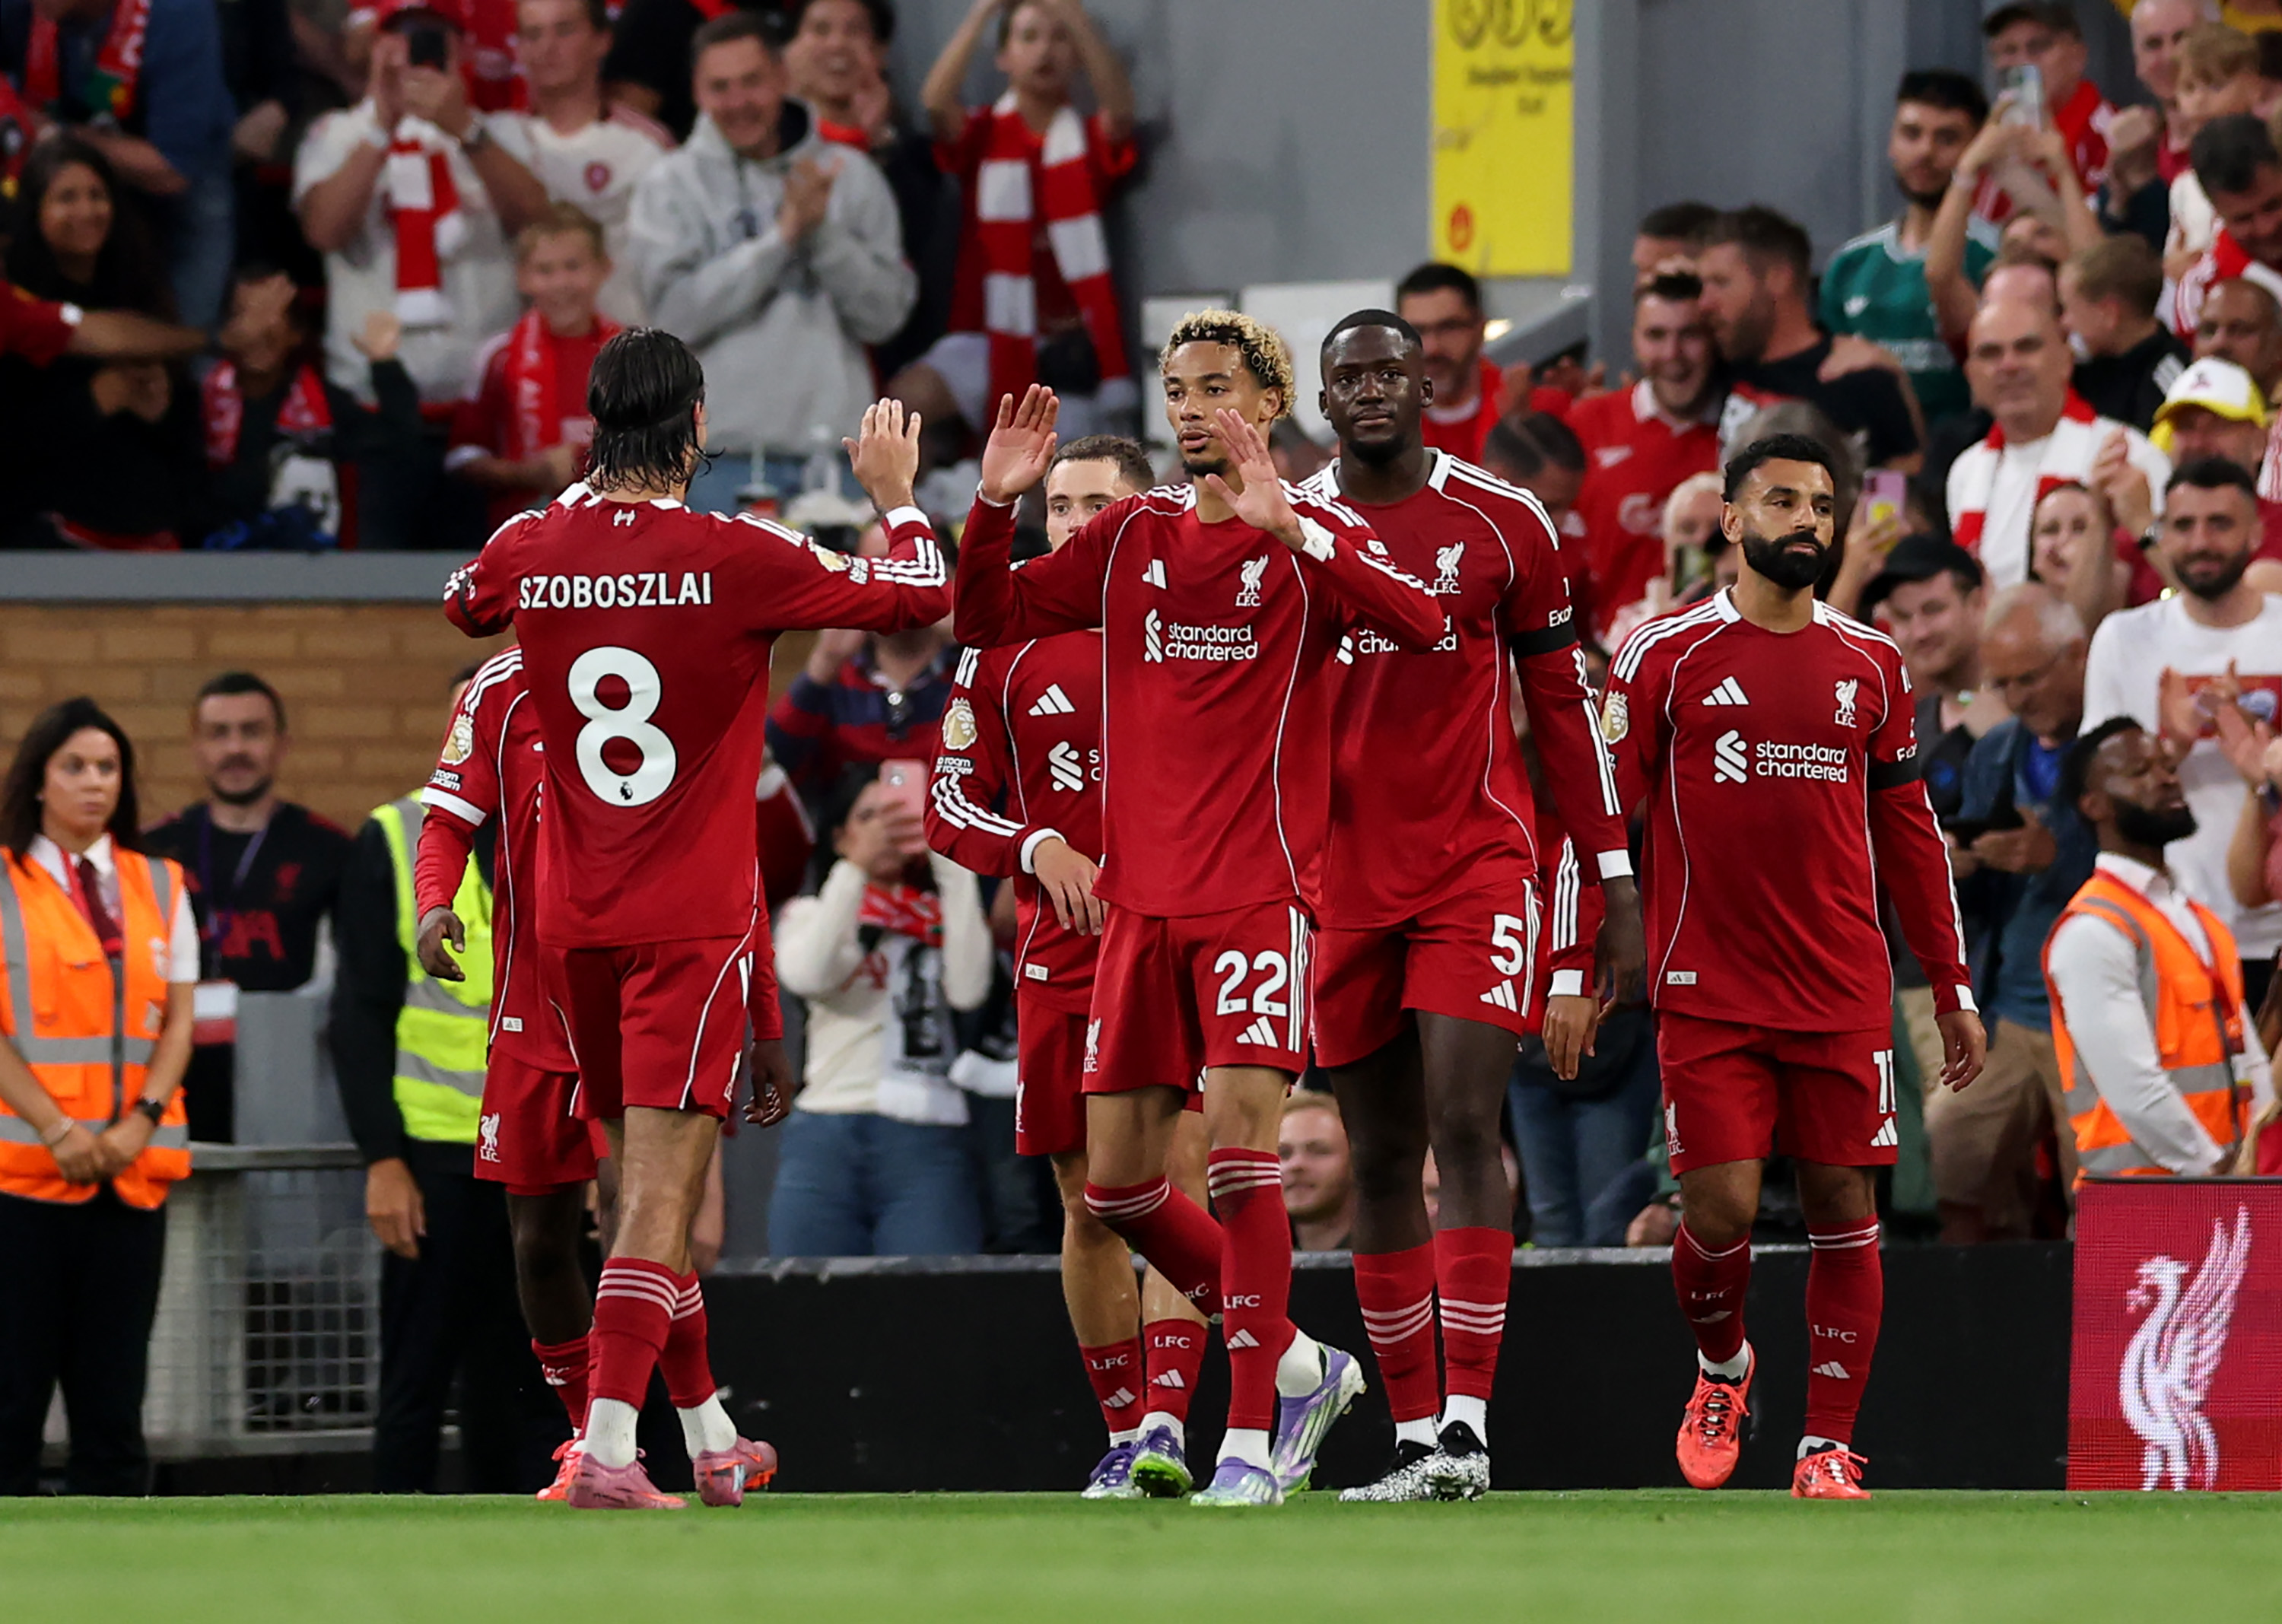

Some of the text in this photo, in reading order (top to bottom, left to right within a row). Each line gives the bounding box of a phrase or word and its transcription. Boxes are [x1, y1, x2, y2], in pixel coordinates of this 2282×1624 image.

[519, 572, 712, 609] SZOBOSZLAI
[1168, 622, 1252, 643] standard
[1165, 640, 1259, 661] chartered
[567, 645, 677, 807] 8
[1756, 740, 1848, 764] standard
[1756, 759, 1848, 783] chartered
[1489, 914, 1524, 977] 5
[1214, 949, 1288, 1018] 22
[1873, 1049, 1897, 1114] 11
[1223, 1295, 1261, 1309] LFC
[1154, 1336, 1191, 1349] LFC
[1813, 1324, 1858, 1343] LFC
[1091, 1354, 1129, 1371] LFC
